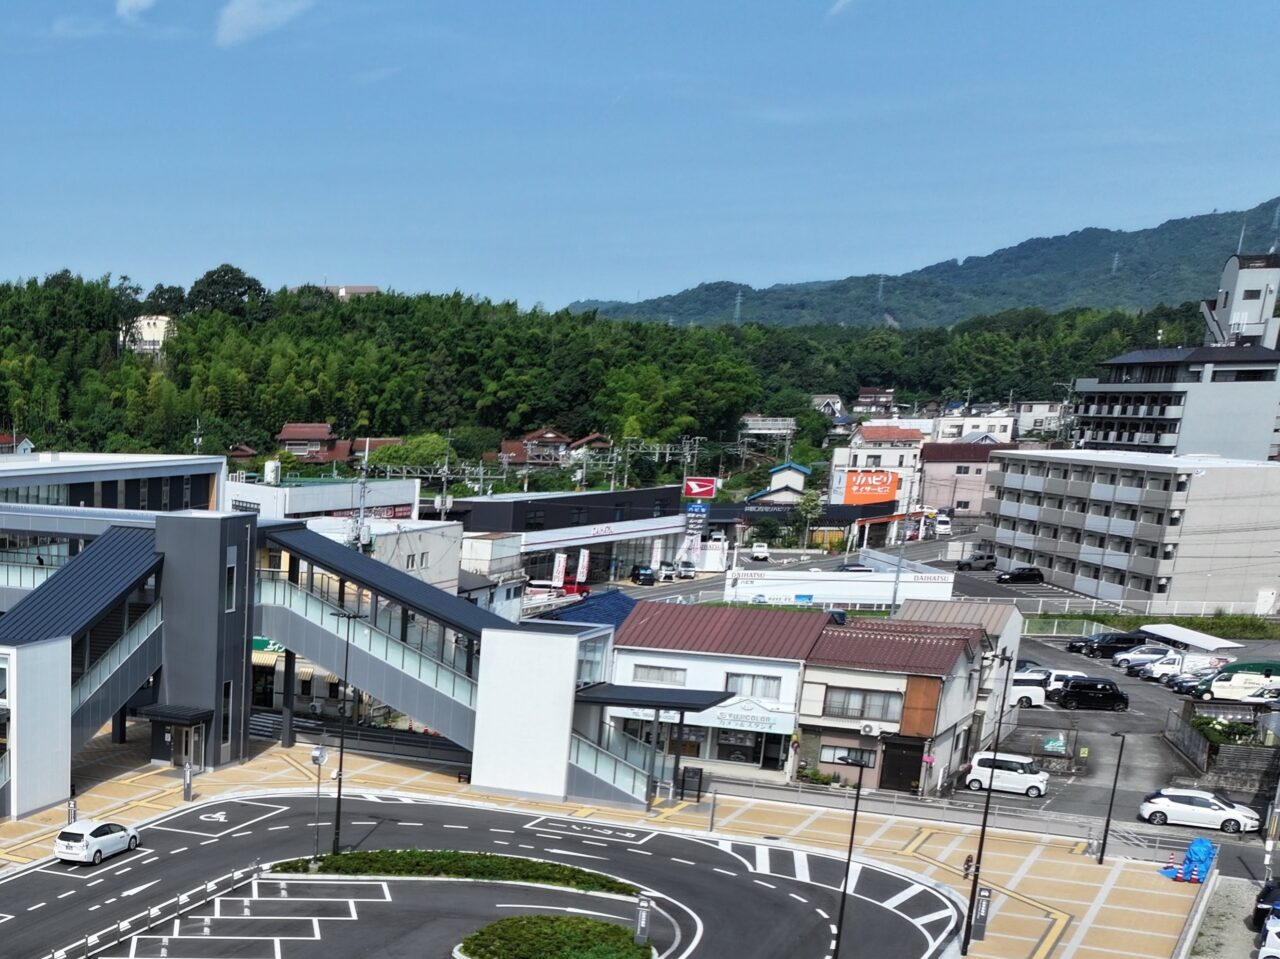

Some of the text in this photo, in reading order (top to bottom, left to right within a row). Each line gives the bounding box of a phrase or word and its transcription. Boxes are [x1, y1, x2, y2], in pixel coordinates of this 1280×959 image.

[852, 472, 893, 485] リハビリ
[547, 822, 637, 838] タクシー
